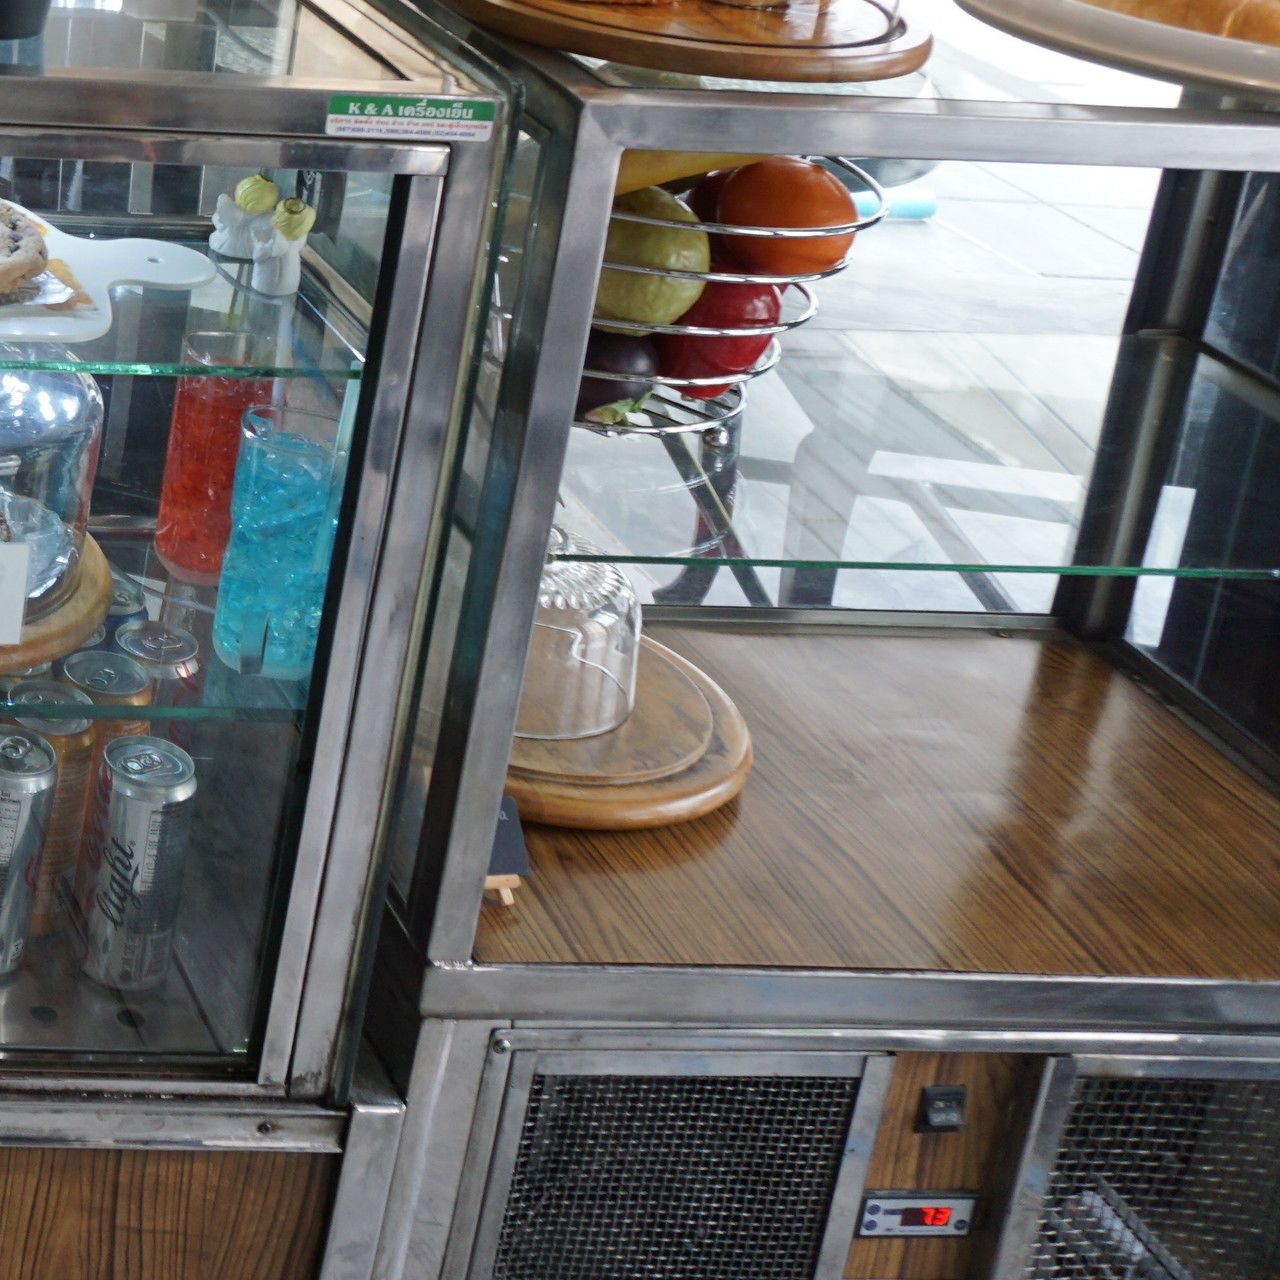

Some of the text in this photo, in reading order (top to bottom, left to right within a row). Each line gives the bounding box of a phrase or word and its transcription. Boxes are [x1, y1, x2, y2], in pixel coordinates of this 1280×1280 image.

[348, 102, 361, 115] K
[364, 103, 378, 116] &
[381, 103, 394, 116] A
